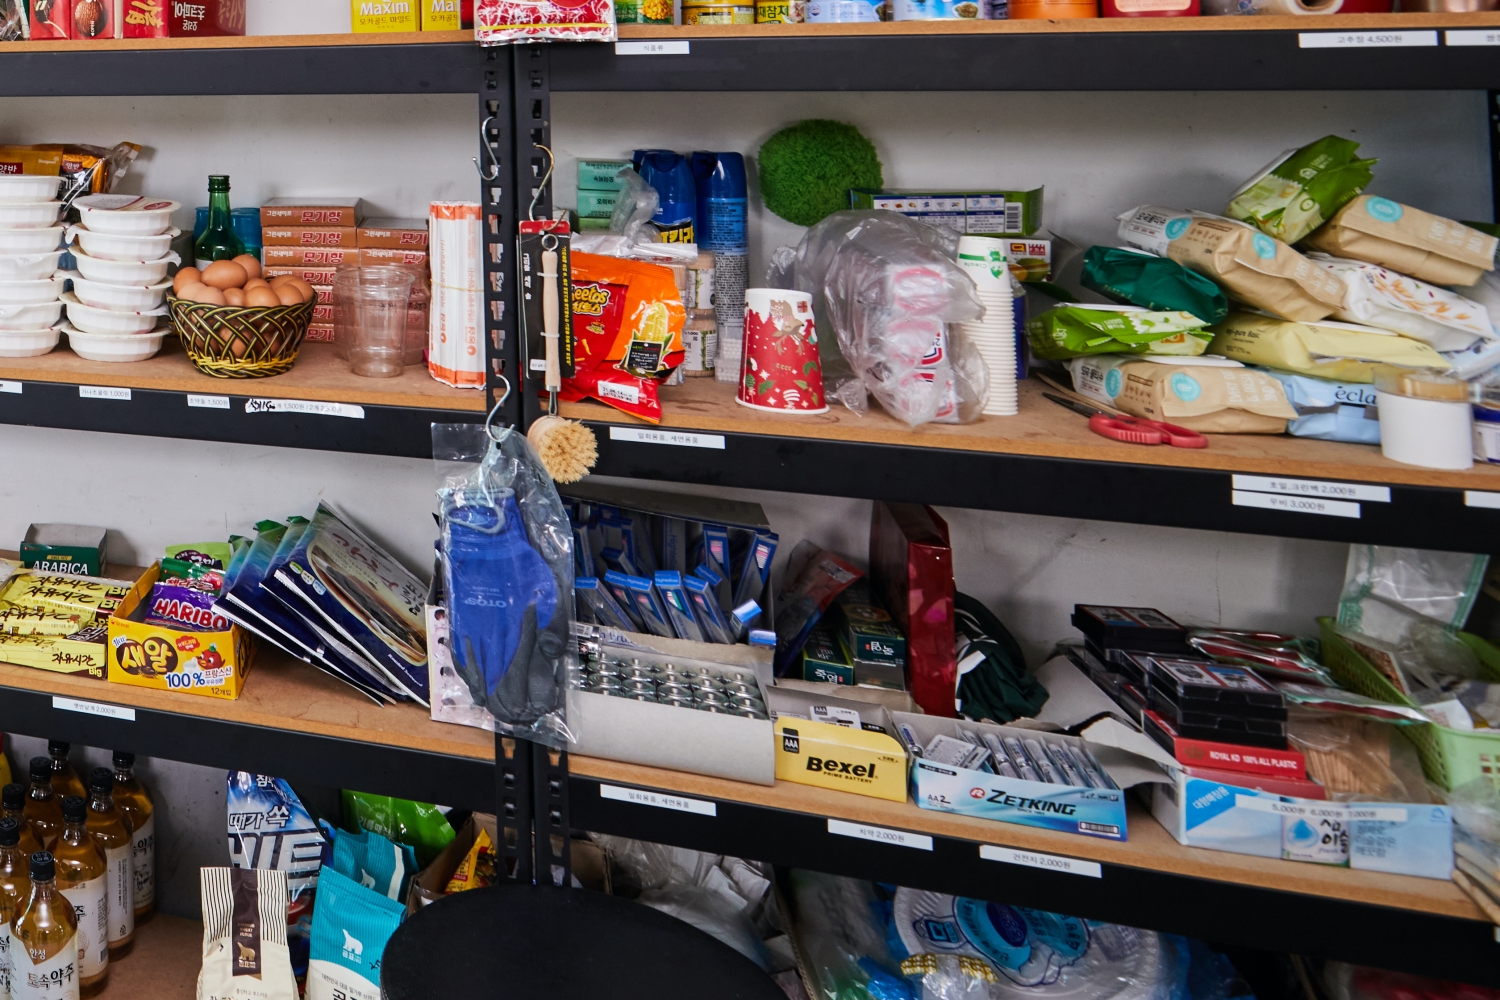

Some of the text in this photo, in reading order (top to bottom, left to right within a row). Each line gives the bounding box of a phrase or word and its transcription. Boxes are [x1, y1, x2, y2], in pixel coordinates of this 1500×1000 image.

[359, 13, 412, 26] 모카골드 마일드
[1366, 34, 1403, 44] 4,500원
[302, 210, 342, 224] 모기향
[301, 231, 342, 245] 모기향
[303, 250, 343, 264] 모기향
[109, 390, 130, 399] 1,000원
[207, 399, 229, 407] 1,500원
[1321, 486, 1356, 498] 2,000원
[1289, 499, 1326, 512] 3,000원
[33, 560, 89, 576] ARABICA
[154, 598, 229, 629] HARIBO
[52, 651, 96, 667] 자유시간
[121, 639, 173, 674] 새알
[88, 667, 103, 678] Big
[204, 667, 232, 679] 프랑스산
[165, 672, 205, 688] 100 %
[211, 687, 232, 696] 12개입
[784, 738, 799, 750] AAA
[806, 755, 876, 779] Bexel
[1210, 751, 1298, 770] ROYAL KD 100% ALL PLASTIC
[823, 771, 873, 784] PRIME BATTERY
[927, 793, 938, 803] AA
[986, 789, 1077, 817] ZETKING
[229, 804, 292, 831] 때가 쏙
[876, 830, 905, 843] 2,000원
[1039, 856, 1072, 870] 2,000원
[29, 948, 46, 961] 안성
[26, 961, 76, 991] 토속약주
